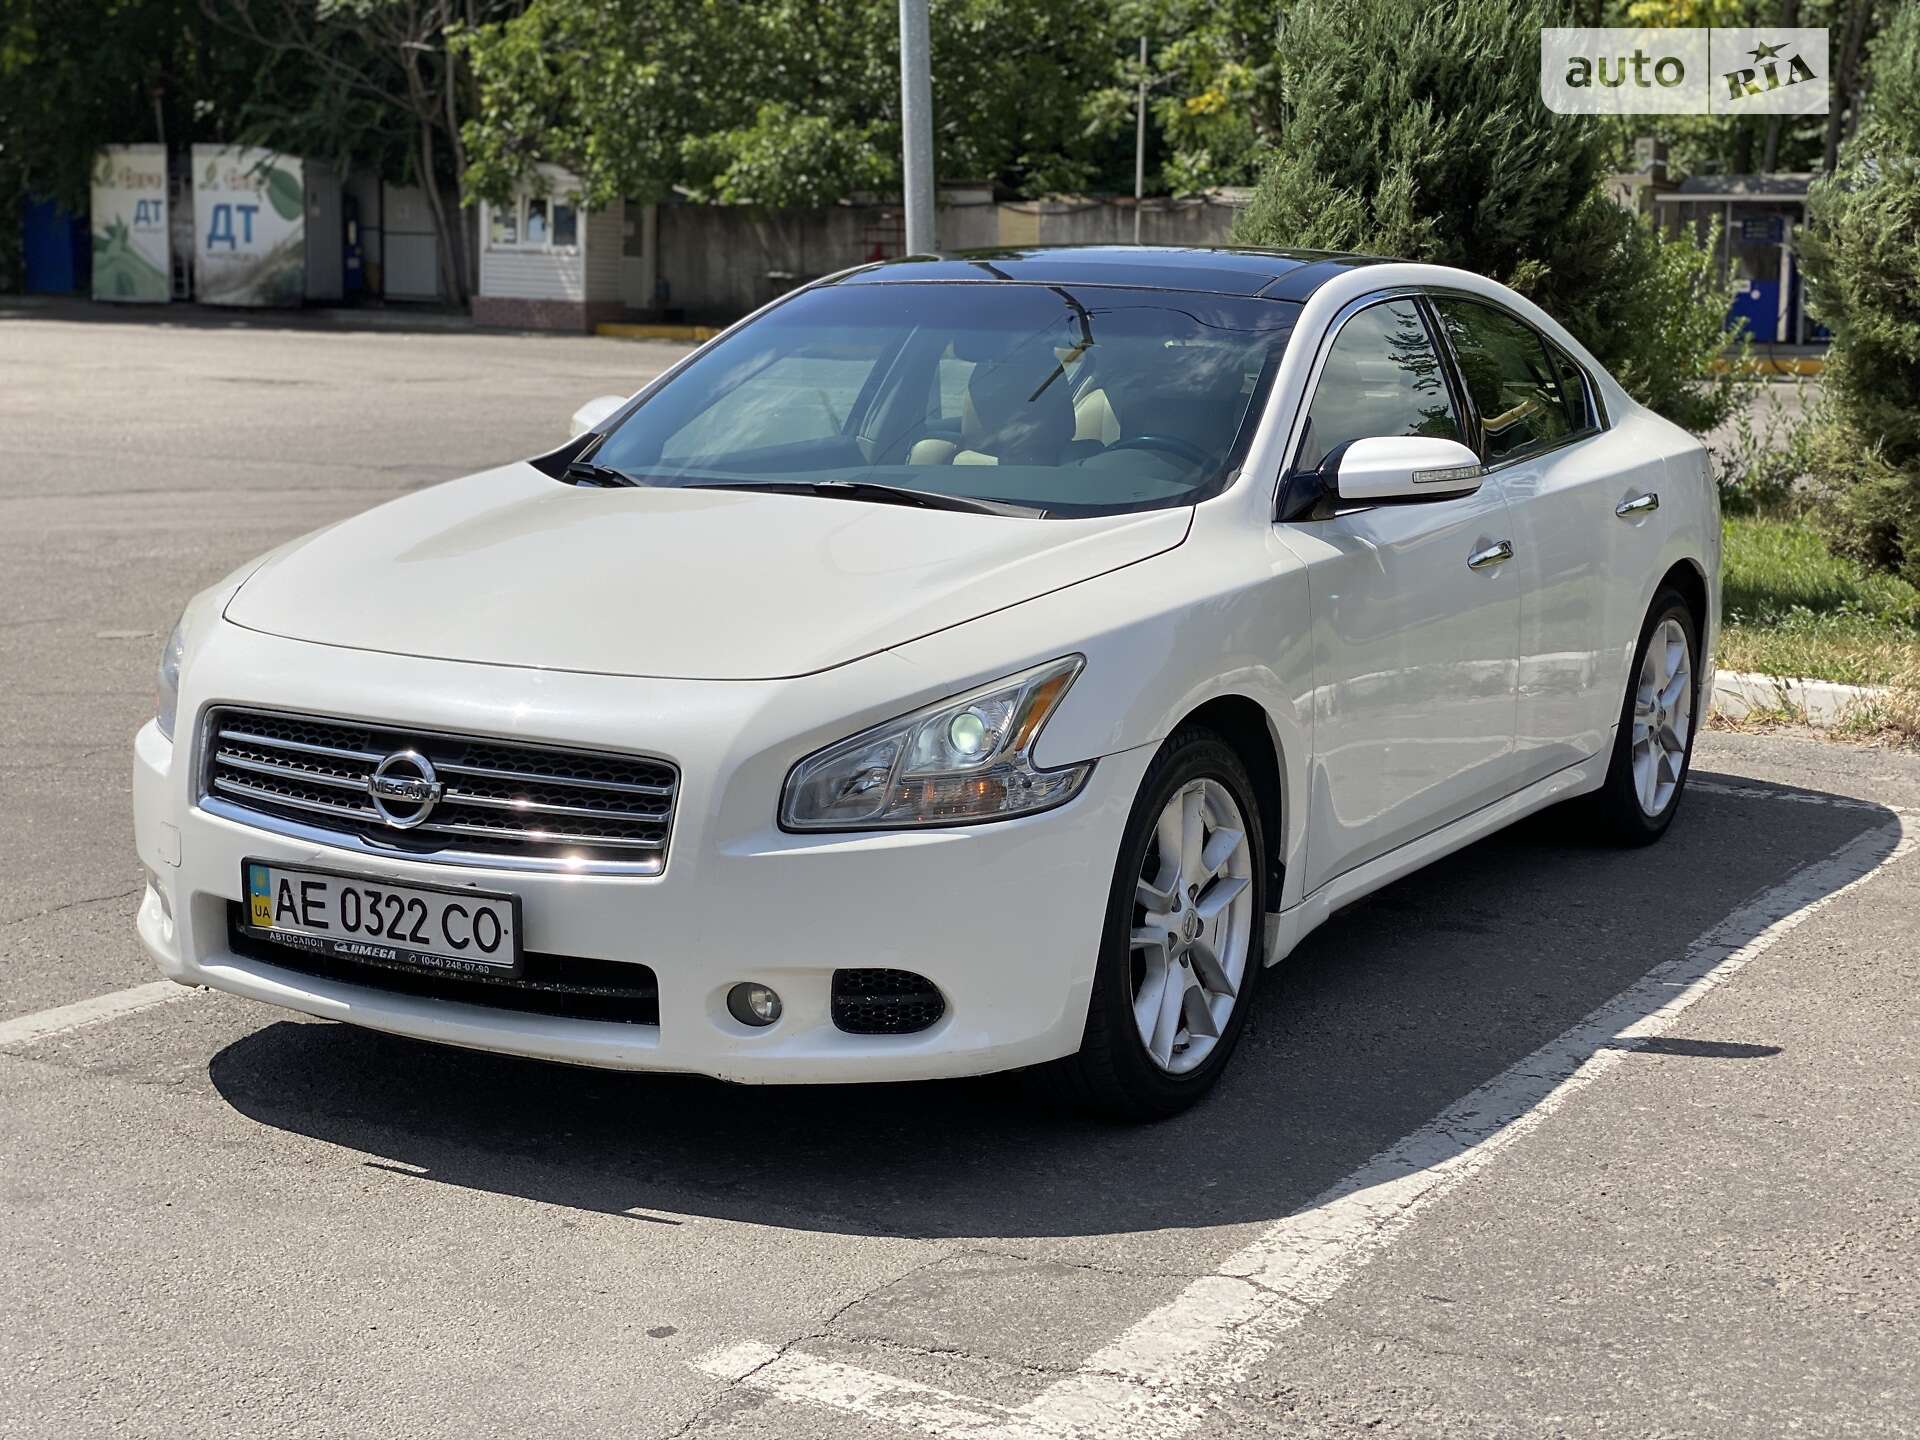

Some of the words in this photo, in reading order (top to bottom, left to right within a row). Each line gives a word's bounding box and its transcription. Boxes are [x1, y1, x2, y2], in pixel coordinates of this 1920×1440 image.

[134, 199, 163, 225] ДТ
[207, 203, 259, 250] ДТ
[370, 779, 432, 799] NISSAN
[254, 903, 271, 919] UA
[275, 878, 329, 929] AE
[340, 886, 430, 945] 0322
[441, 903, 501, 953] CO
